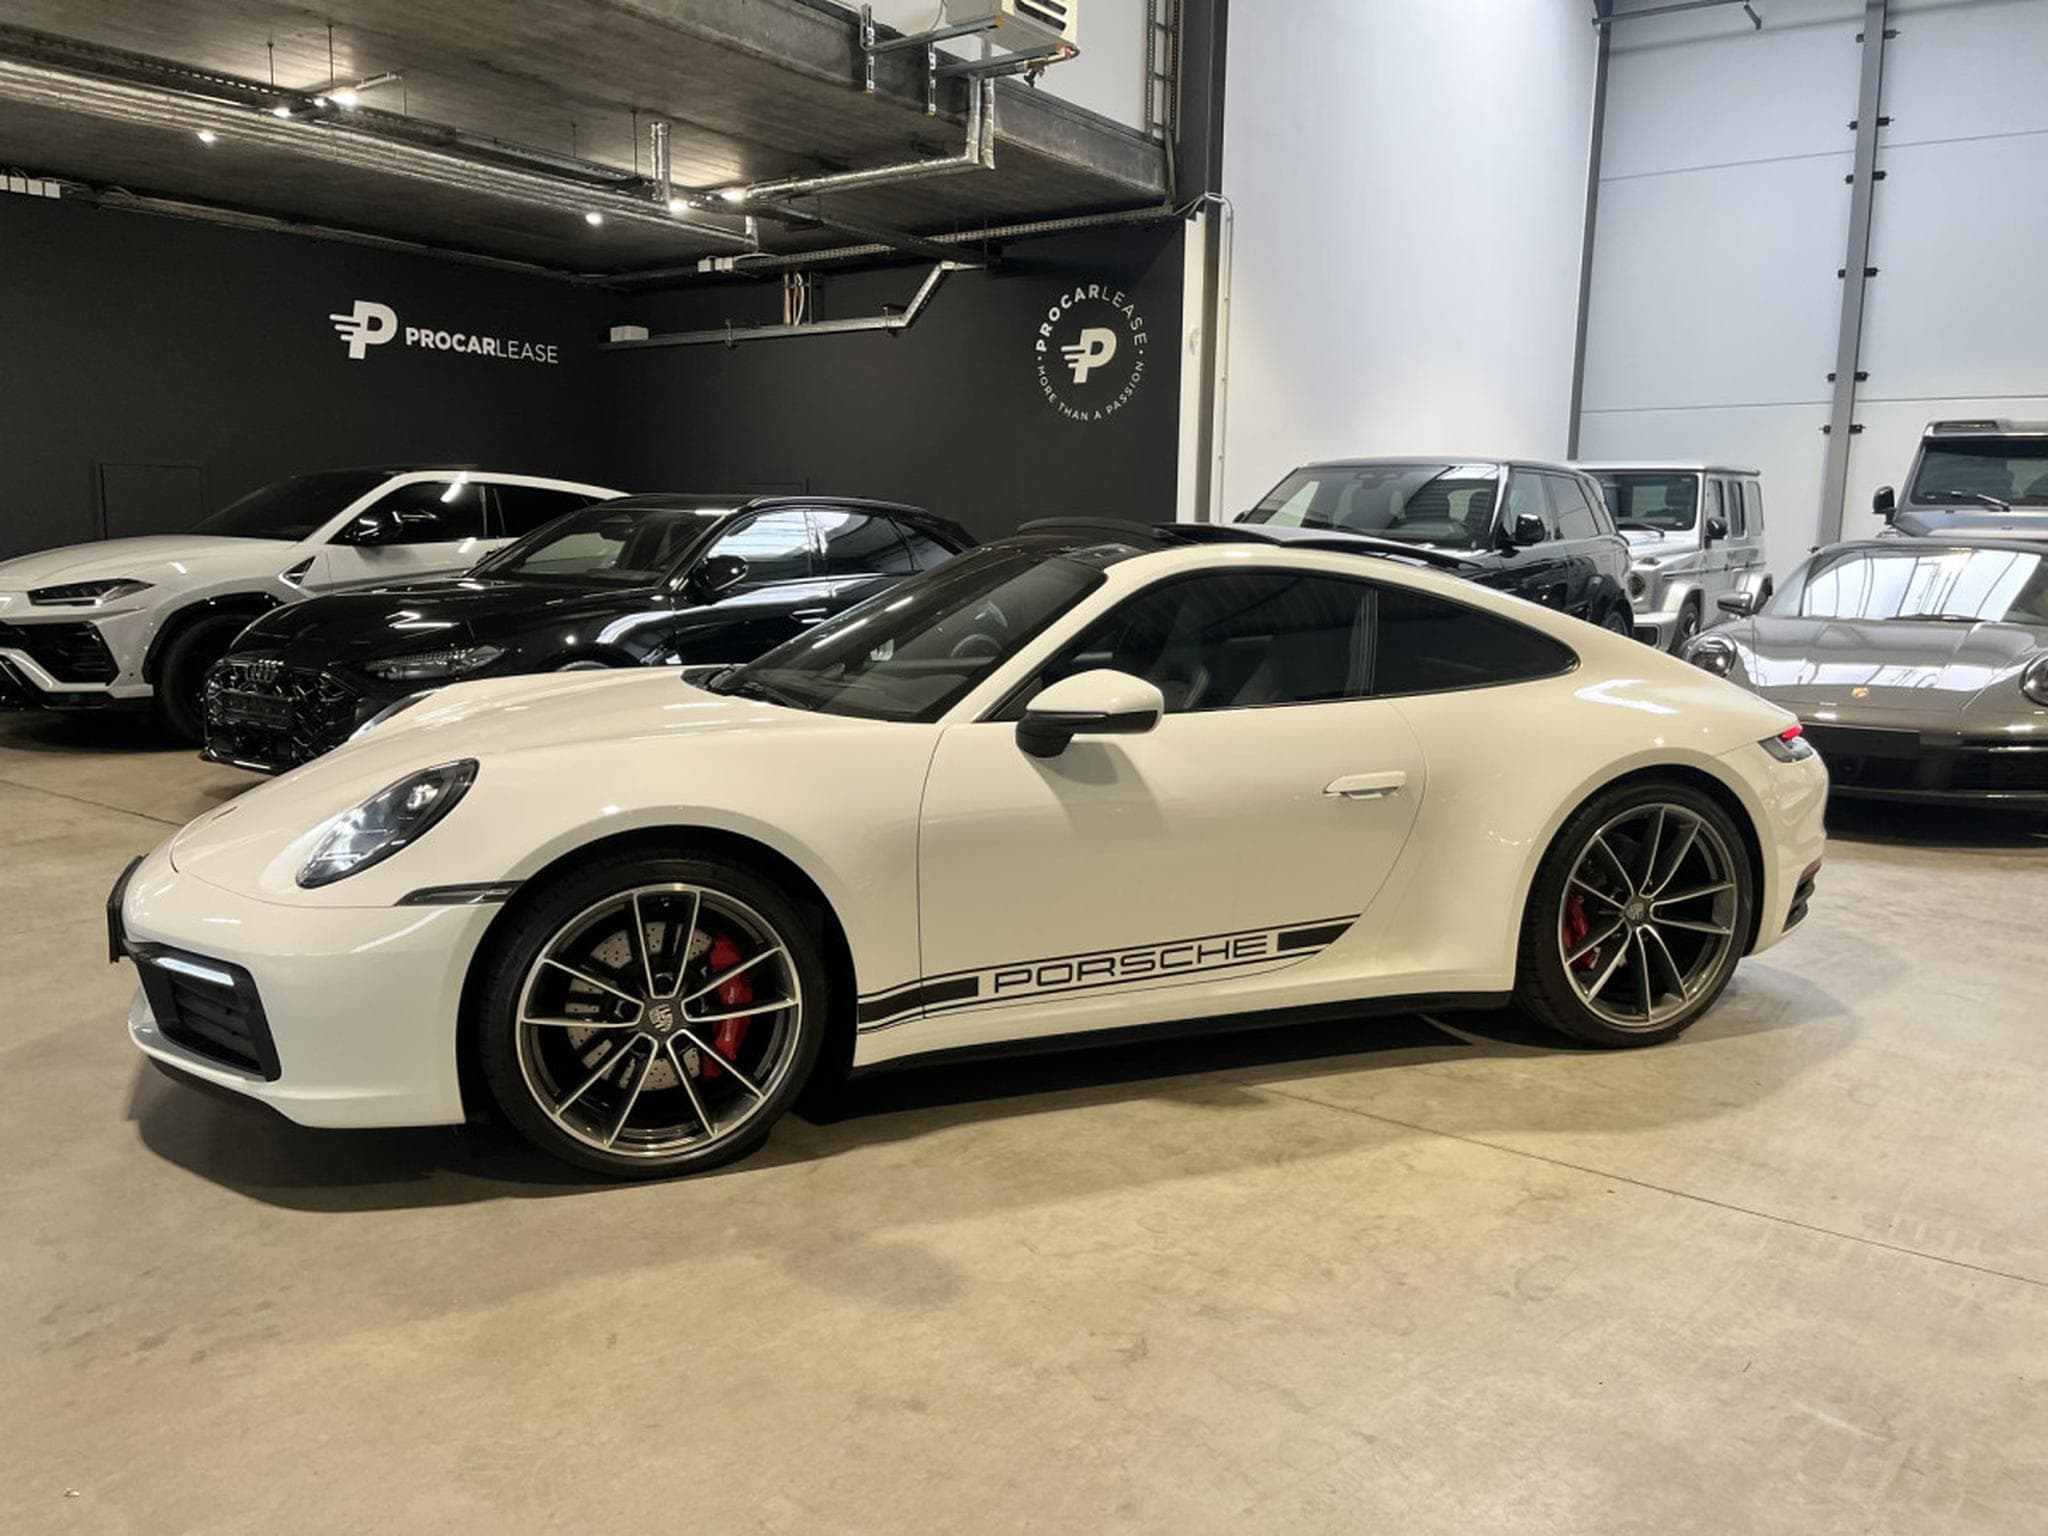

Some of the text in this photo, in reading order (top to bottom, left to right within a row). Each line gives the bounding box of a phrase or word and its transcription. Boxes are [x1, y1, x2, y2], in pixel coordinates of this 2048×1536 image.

[405, 327, 559, 364] PROCARLEASE
[1035, 284, 1148, 352] PROCARLEASE
[1037, 361, 1144, 421] MORE THAN A PASSION
[994, 935, 1268, 994] PORSCHE
